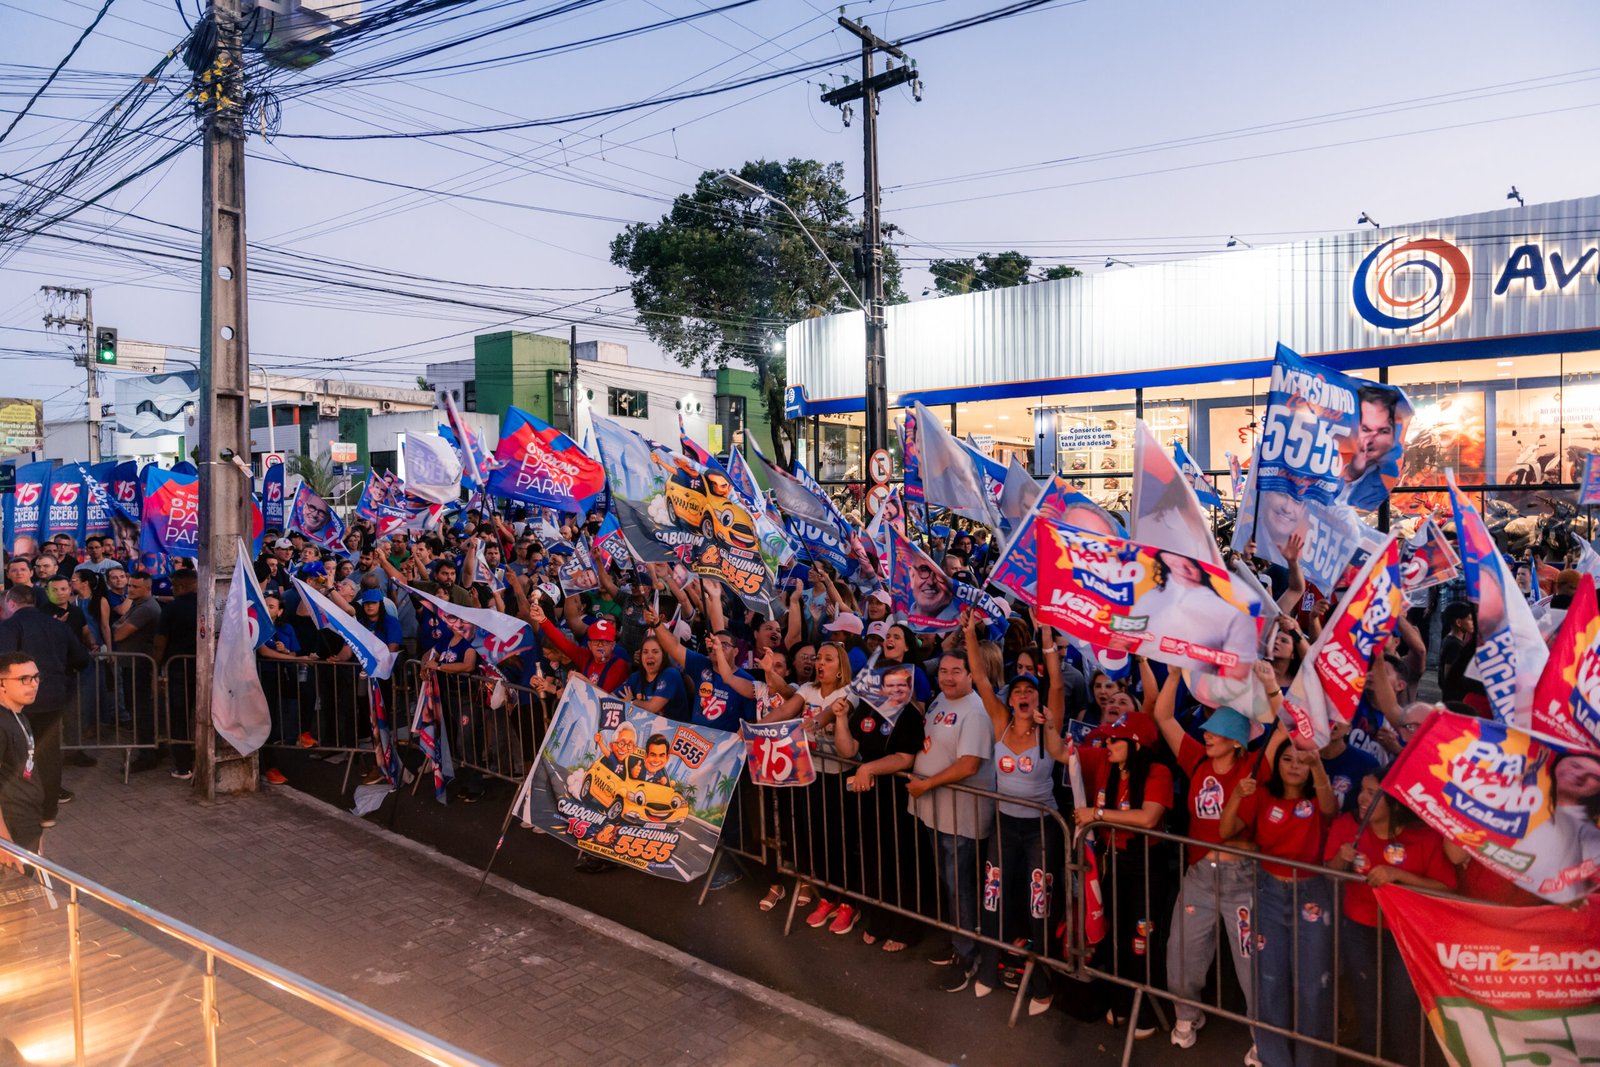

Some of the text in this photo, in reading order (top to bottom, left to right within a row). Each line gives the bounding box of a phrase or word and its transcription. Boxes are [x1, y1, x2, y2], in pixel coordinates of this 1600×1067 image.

[1270, 365, 1355, 414] MERSINHO
[1261, 404, 1351, 477] 5555
[17, 483, 42, 506] 15
[54, 483, 81, 505] 15
[117, 481, 136, 502] 15
[267, 482, 281, 502] 15
[50, 510, 78, 520] CICERO
[1081, 573, 1129, 602] Valer!
[604, 711, 620, 728] 15
[702, 696, 727, 720] 15
[677, 729, 710, 752] GALEGUINHO
[780, 724, 789, 736] é
[673, 738, 704, 765] 5555
[760, 736, 792, 781] 15
[558, 800, 607, 825] CABOQUIM
[1455, 792, 1522, 833] Valer!
[567, 817, 592, 838] 15
[596, 824, 615, 843] &
[618, 826, 680, 844] GALEGUINHO
[614, 835, 676, 863] 5555
[1436, 942, 1600, 971] Veneziano
[1474, 975, 1503, 983] MEU
[1509, 976, 1549, 985] VOTO
[1491, 989, 1531, 998] Lucena
[1536, 989, 1568, 998] Paulo
